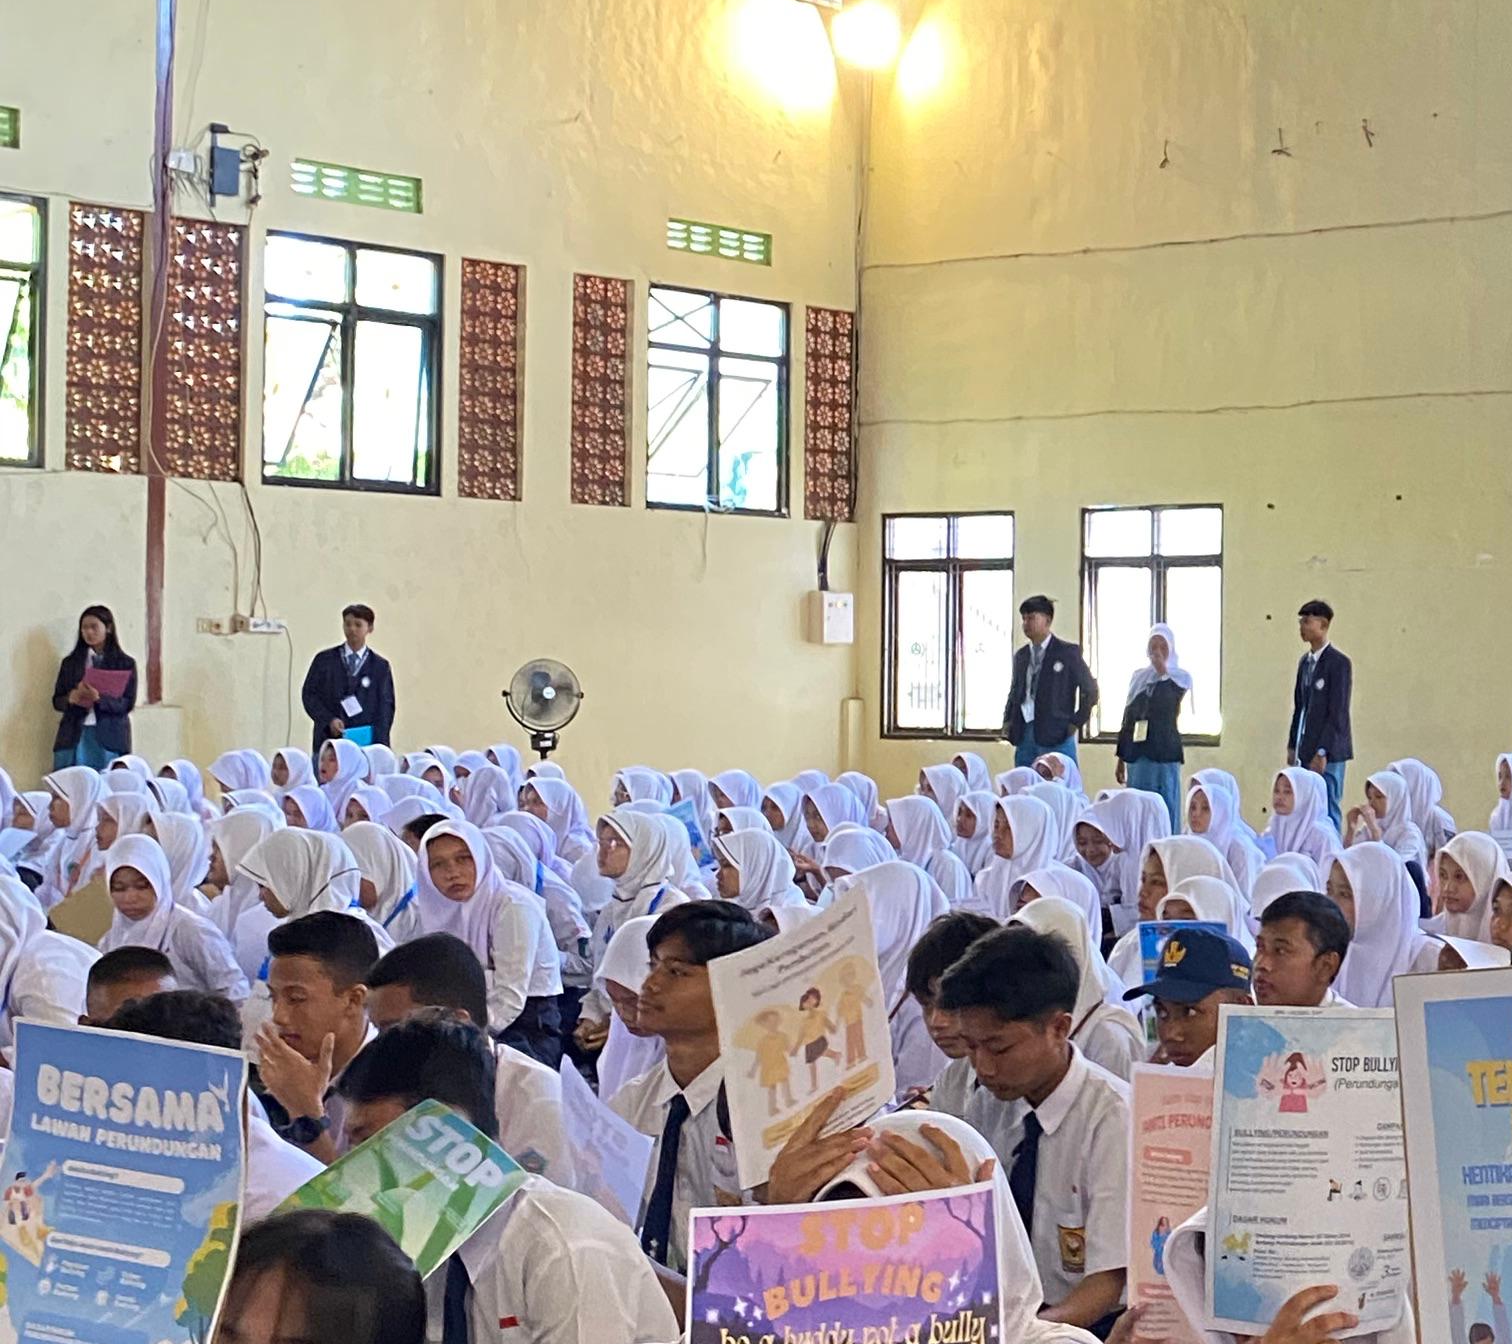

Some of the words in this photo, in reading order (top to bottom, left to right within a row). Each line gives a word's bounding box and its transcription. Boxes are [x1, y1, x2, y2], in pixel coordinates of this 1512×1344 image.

[1331, 1056, 1360, 1073] STOP
[1363, 1056, 1400, 1073] BULLYI
[1334, 1077, 1399, 1091] (Perundunga
[37, 1063, 226, 1134] BERSAMA
[30, 1112, 92, 1143] LAWAN
[95, 1128, 222, 1162] PERUNDUNGAN
[405, 1115, 504, 1188] STOP
[800, 1201, 926, 1256] STOP
[763, 1263, 945, 1321] BULLYING
